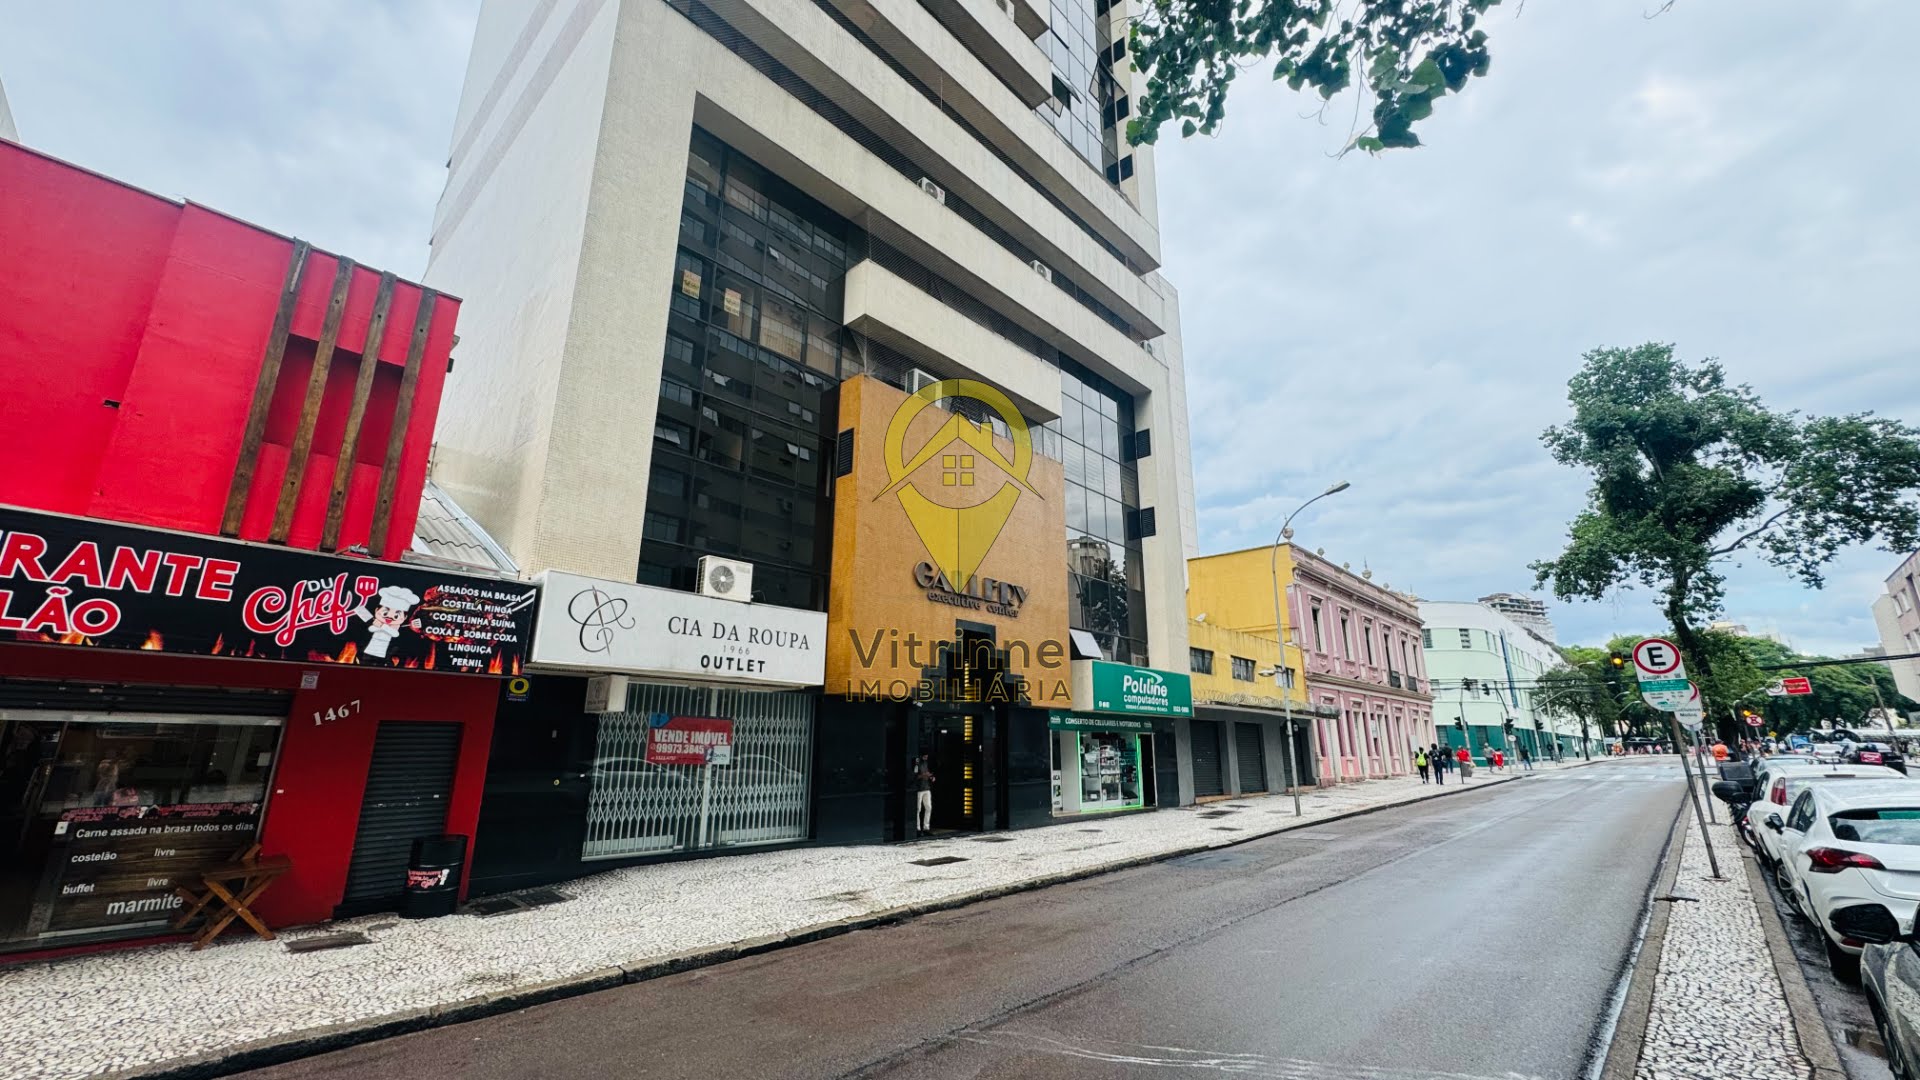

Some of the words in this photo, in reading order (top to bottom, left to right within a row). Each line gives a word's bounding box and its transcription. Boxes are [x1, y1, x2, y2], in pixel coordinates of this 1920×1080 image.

[0, 529, 241, 602] RANTE
[308, 577, 333, 592] DU
[437, 584, 479, 597] ASSADOS
[481, 591, 492, 599] NA
[494, 592, 522, 602] BRASA
[0, 586, 121, 636] LÃO
[242, 572, 356, 647] Chef
[442, 600, 482, 611] COSTELA
[928, 591, 981, 610] executive
[986, 604, 1019, 617] center
[432, 612, 489, 626] COSTELINHA
[490, 618, 516, 629] SUÍNA
[425, 626, 452, 636] COXA
[454, 629, 460, 637] E
[463, 630, 492, 640] SOBRE
[493, 633, 518, 643] COXA
[668, 616, 702, 637] CIA
[712, 622, 740, 641] DA
[749, 627, 810, 650] ROUPA
[448, 643, 492, 655] LINGUIÇA
[723, 645, 751, 655] 1966
[1646, 646, 1666, 666] E
[452, 657, 484, 668] PERNIL
[700, 654, 766, 673] OUTLET
[1123, 694, 1168, 707] computadores
[313, 699, 361, 727] 1467
[654, 729, 689, 743] VENDE
[690, 730, 728, 745] IMÓVEL
[76, 829, 108, 839] Carne
[110, 824, 147, 836] assada
[150, 826, 161, 834] na
[164, 824, 192, 834] brasa
[193, 823, 220, 832] todos
[222, 823, 233, 832] os
[71, 852, 117, 863] costelão
[154, 848, 175, 857] livre
[62, 883, 95, 895] buffet
[147, 877, 169, 887] livre
